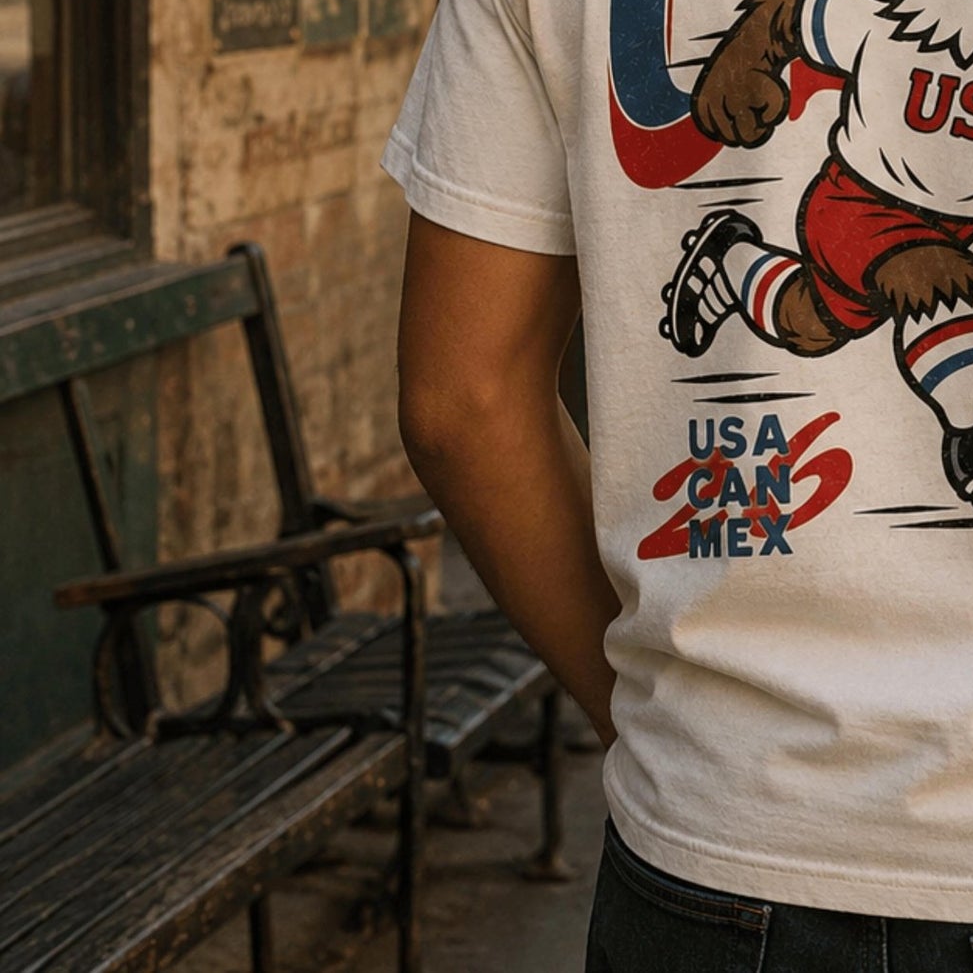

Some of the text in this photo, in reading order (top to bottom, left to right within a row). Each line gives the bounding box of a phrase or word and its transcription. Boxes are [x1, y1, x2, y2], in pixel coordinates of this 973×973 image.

[689, 414, 789, 459] USA
[688, 465, 790, 509] CAN
[689, 514, 793, 559] MEX
